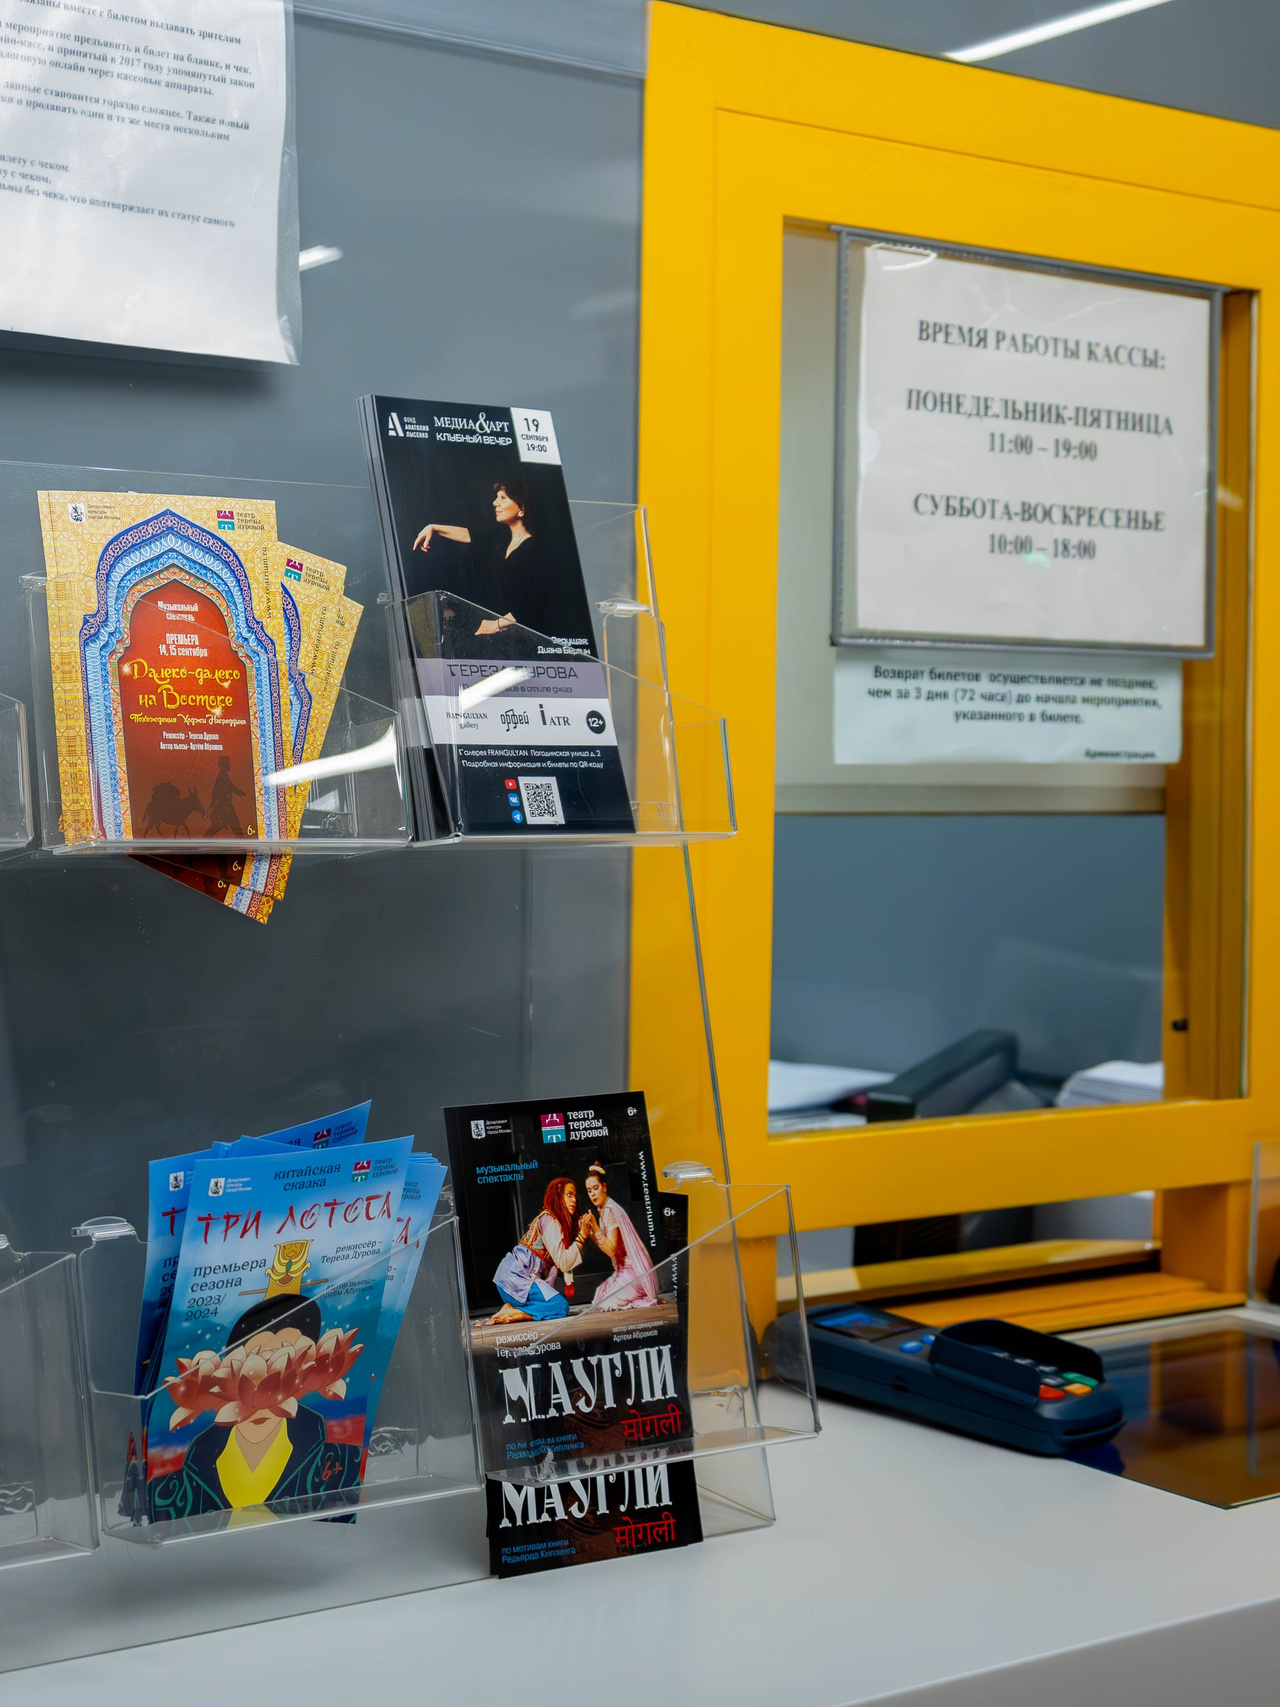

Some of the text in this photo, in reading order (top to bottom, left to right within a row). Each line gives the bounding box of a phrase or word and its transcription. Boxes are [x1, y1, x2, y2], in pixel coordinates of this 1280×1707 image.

[107, 10, 241, 46] билетом выдавать зрителям
[119, 55, 255, 90] 2017 году упомянутый закон
[88, 66, 214, 96] через кассовые аппараты.
[186, 110, 216, 125] Также
[917, 320, 1166, 370] ВРЕМЯ РАБОТЫ КАССЫ:
[906, 388, 1173, 436] ПОНЕДЕЛЬНИК-ПЯТНИЦА
[404, 416, 417, 424] ФОНД
[523, 418, 539, 432] 19
[436, 433, 513, 446] КЛУБНЫЙ ВЕЧЕР
[521, 433, 549, 442] СЕНТЯБРЯ
[526, 443, 547, 453] 19:00
[988, 433, 1098, 462] 11:00 19:00
[236, 511, 256, 519] театр
[913, 493, 1165, 532] СУББОТА-ВОСКРЕСЕНЬЕ
[237, 517, 261, 526] терезы
[238, 523, 265, 532] дуровой
[988, 534, 1096, 560] 10:00 18:00
[262, 546, 272, 618] www.teatrium.ru
[157, 600, 199, 613] Музыкальный
[166, 634, 199, 646] ПРЕМЬЕРА
[158, 645, 208, 659] 14, 15 сентября
[537, 646, 563, 655] Диана
[130, 659, 240, 688] Далеко-далеко
[874, 665, 1086, 687] Возврат билетов осуществляется
[526, 685, 551, 694] стиле
[553, 686, 573, 695] джаз
[868, 688, 892, 699] чем
[896, 689, 911, 699] за
[926, 689, 949, 702] дня
[954, 688, 975, 703] (72
[1016, 692, 1031, 705] до
[139, 685, 233, 711] на Востоке
[130, 714, 176, 725] Похождения
[177, 715, 206, 725] Ходжи
[549, 716, 571, 726] ATR
[587, 717, 604, 728] 12+
[953, 710, 1084, 724] указанного билете.
[458, 748, 589, 758] Галерея FRANGULYAN Погодинская улица
[462, 760, 604, 769] Подробная информация билеты QR-коду
[567, 1110, 594, 1121] театр
[627, 1107, 638, 1116] 6+
[568, 1118, 603, 1130] терезы
[570, 1127, 608, 1140] дуровой
[373, 1164, 396, 1173] терезы
[374, 1157, 393, 1167] театр
[476, 1160, 538, 1174] музыкальный
[274, 1162, 341, 1181] китайская
[371, 1168, 398, 1179] дуровой
[477, 1172, 524, 1184] спектакль
[283, 1177, 327, 1192] сказка
[638, 1150, 657, 1247] www.teatrium.ru
[197, 1191, 394, 1245] ТРИ ЛОТОСА
[664, 1208, 676, 1217] 6+
[335, 1240, 375, 1254] режиссёр
[321, 1247, 381, 1264] Тереза Дурова
[193, 1257, 267, 1279] премьера
[190, 1276, 242, 1293] сезона
[187, 1294, 227, 1310] 2023/
[185, 1307, 219, 1321] 2024
[495, 1331, 539, 1345] режиссёр
[632, 1329, 658, 1340] Абрамов
[498, 1344, 678, 1425] МАУГЛИ
[620, 1404, 682, 1440] मोगली
[322, 1461, 343, 1480] 6+
[613, 1512, 676, 1548] मोगली
[512, 1538, 569, 1553] мотивам книги
[502, 1546, 576, 1564] Редьярда Киплинга
